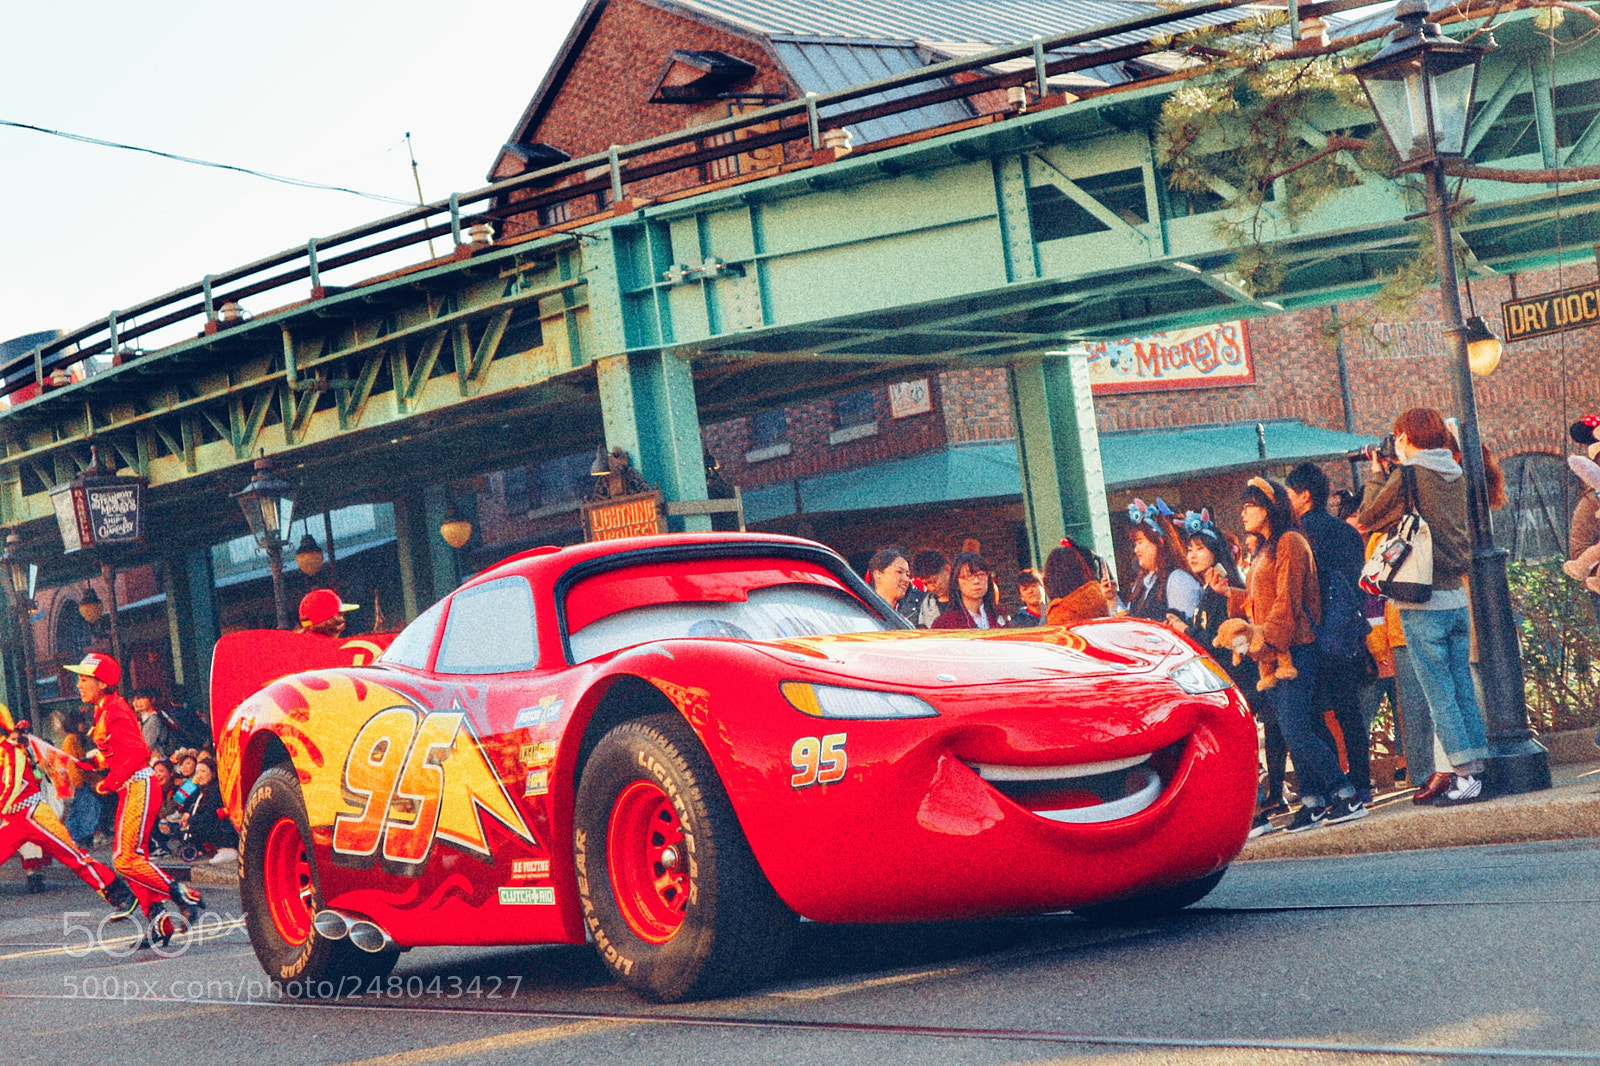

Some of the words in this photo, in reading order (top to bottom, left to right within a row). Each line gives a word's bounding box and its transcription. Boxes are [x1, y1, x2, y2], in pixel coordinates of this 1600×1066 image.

[1510, 301, 1549, 335] DRY
[591, 499, 657, 532] LIGHTNING
[333, 705, 464, 864] 95
[791, 732, 848, 788] 95
[638, 751, 699, 905] LIGHTYEAR
[501, 890, 531, 903] CLUTCH
[575, 828, 634, 976] LIGHTYEAR
